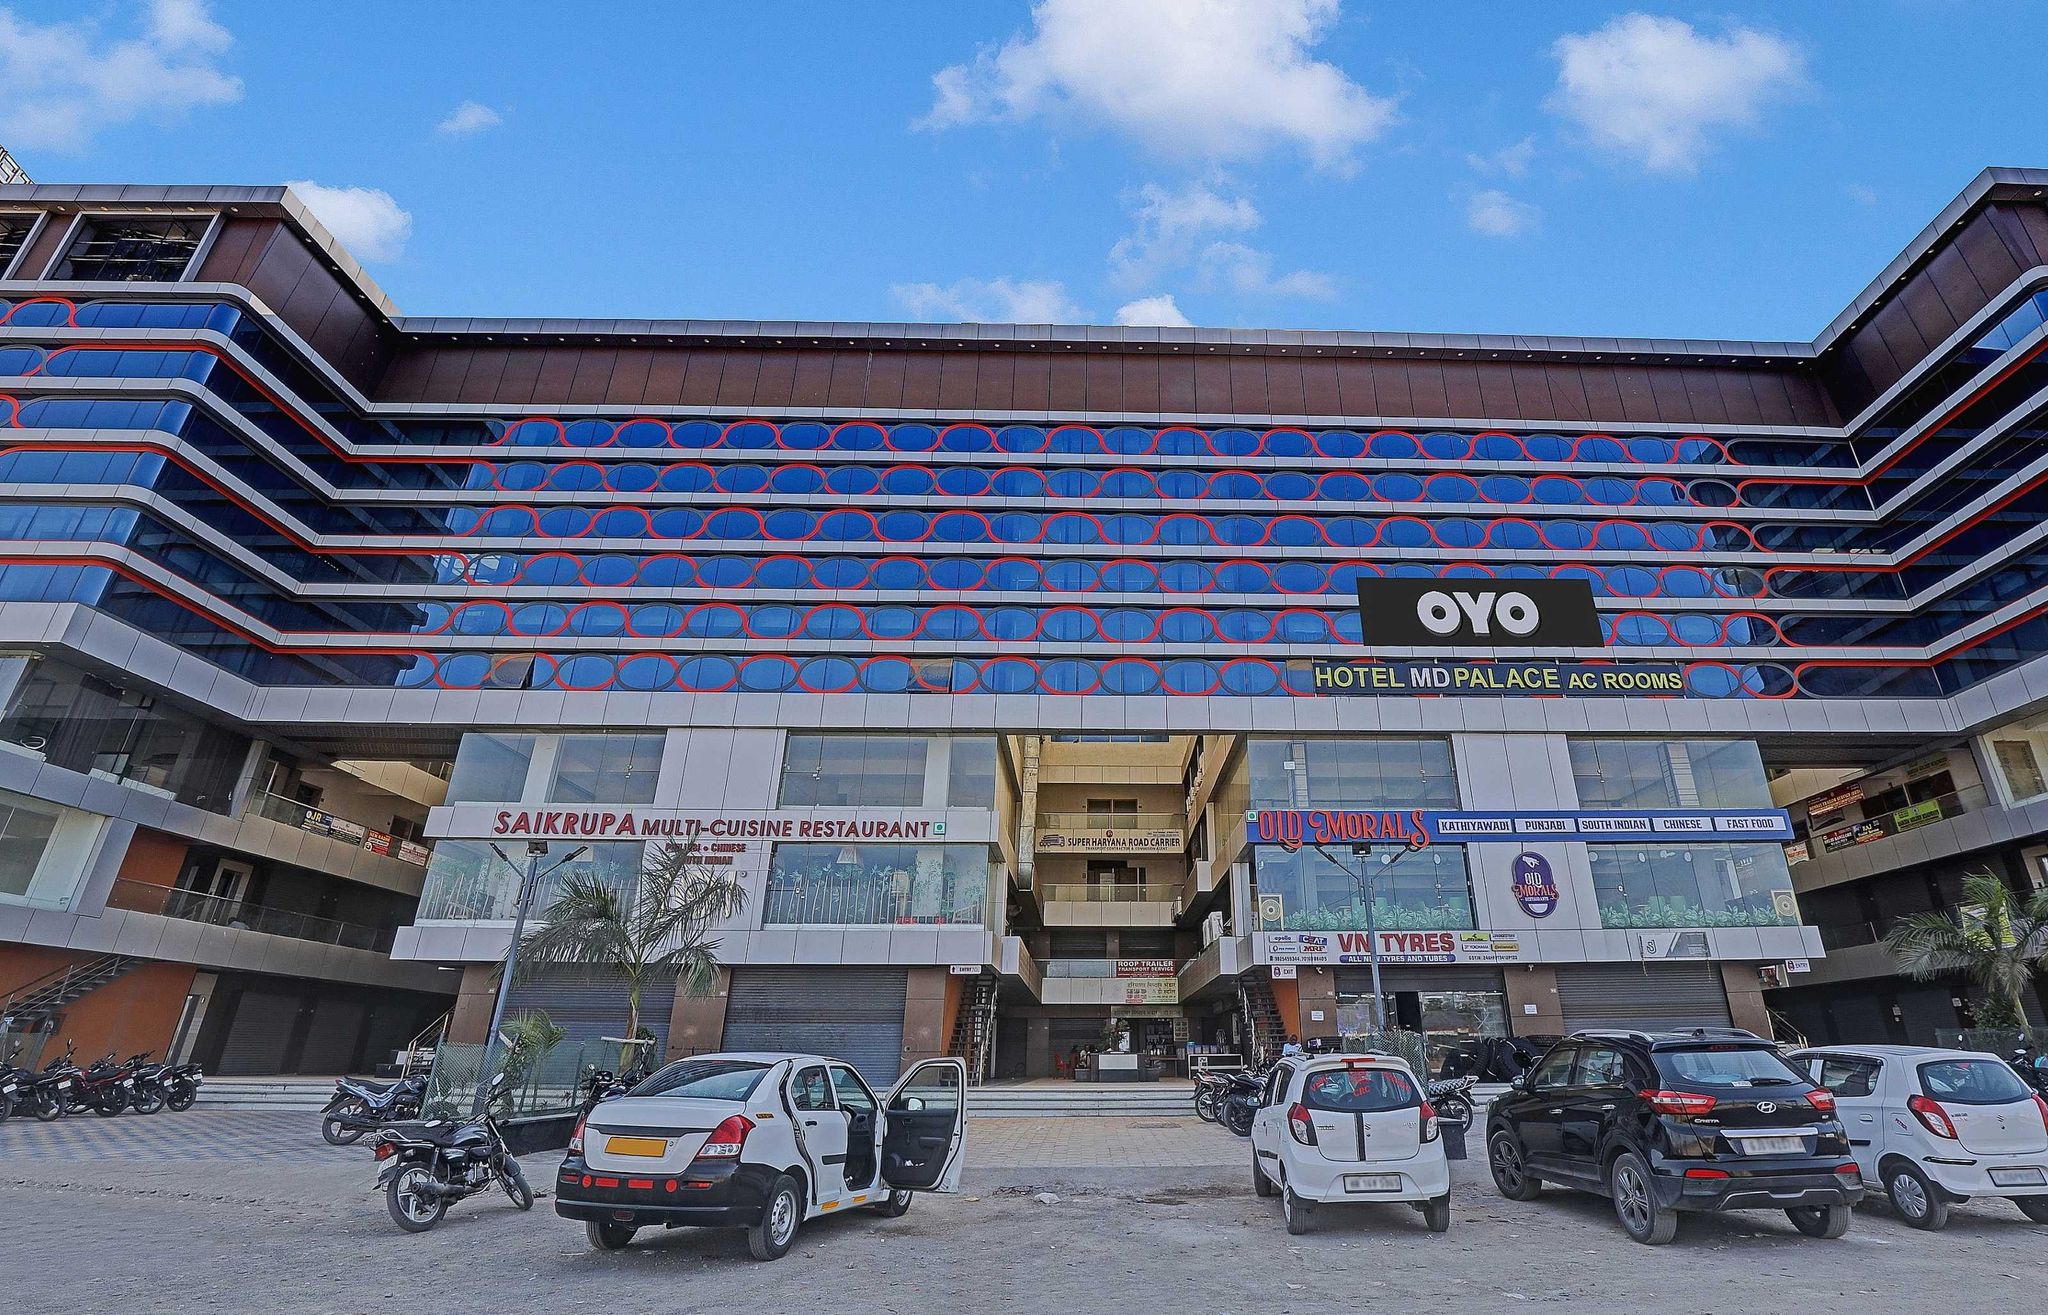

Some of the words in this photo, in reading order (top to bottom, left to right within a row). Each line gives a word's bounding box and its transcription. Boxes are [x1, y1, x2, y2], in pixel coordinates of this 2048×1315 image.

[1416, 590, 1541, 636] OYO
[1314, 666, 1405, 689] HOTEL
[1410, 667, 1451, 689] MD
[1454, 667, 1561, 690] PALACE
[1568, 672, 1598, 689] AC
[1603, 673, 1683, 690] ROOMS
[494, 811, 637, 836] SAIKRUPA
[641, 819, 793, 837] MULTI-CUISINE
[799, 820, 930, 838] RESTAURANT
[1441, 820, 1510, 832] KATHIYAWADI
[1525, 820, 1566, 831] PUNJABI
[1582, 820, 1612, 831] SOUTH
[1614, 819, 1647, 830] INDIAN
[1663, 819, 1703, 830] CHINESE
[1727, 818, 1749, 829] FAST
[1751, 818, 1774, 829] FOOD
[1258, 810, 1304, 850] OLD
[1307, 810, 1430, 849] MORALS
[711, 843, 747, 853] CHINESE
[1067, 837, 1091, 847] SUPER
[1091, 837, 1127, 847] HARYANA
[1129, 837, 1149, 847] ROAD
[1150, 837, 1181, 847] CARRIER
[1524, 872, 1543, 888] OLD
[1511, 883, 1560, 901] MORALS
[1302, 936, 1325, 945] CEAT
[1337, 933, 1371, 953] VN
[1380, 933, 1456, 953] TYRES
[1348, 955, 1362, 963] ALL
[1424, 954, 1448, 962] TUBES
